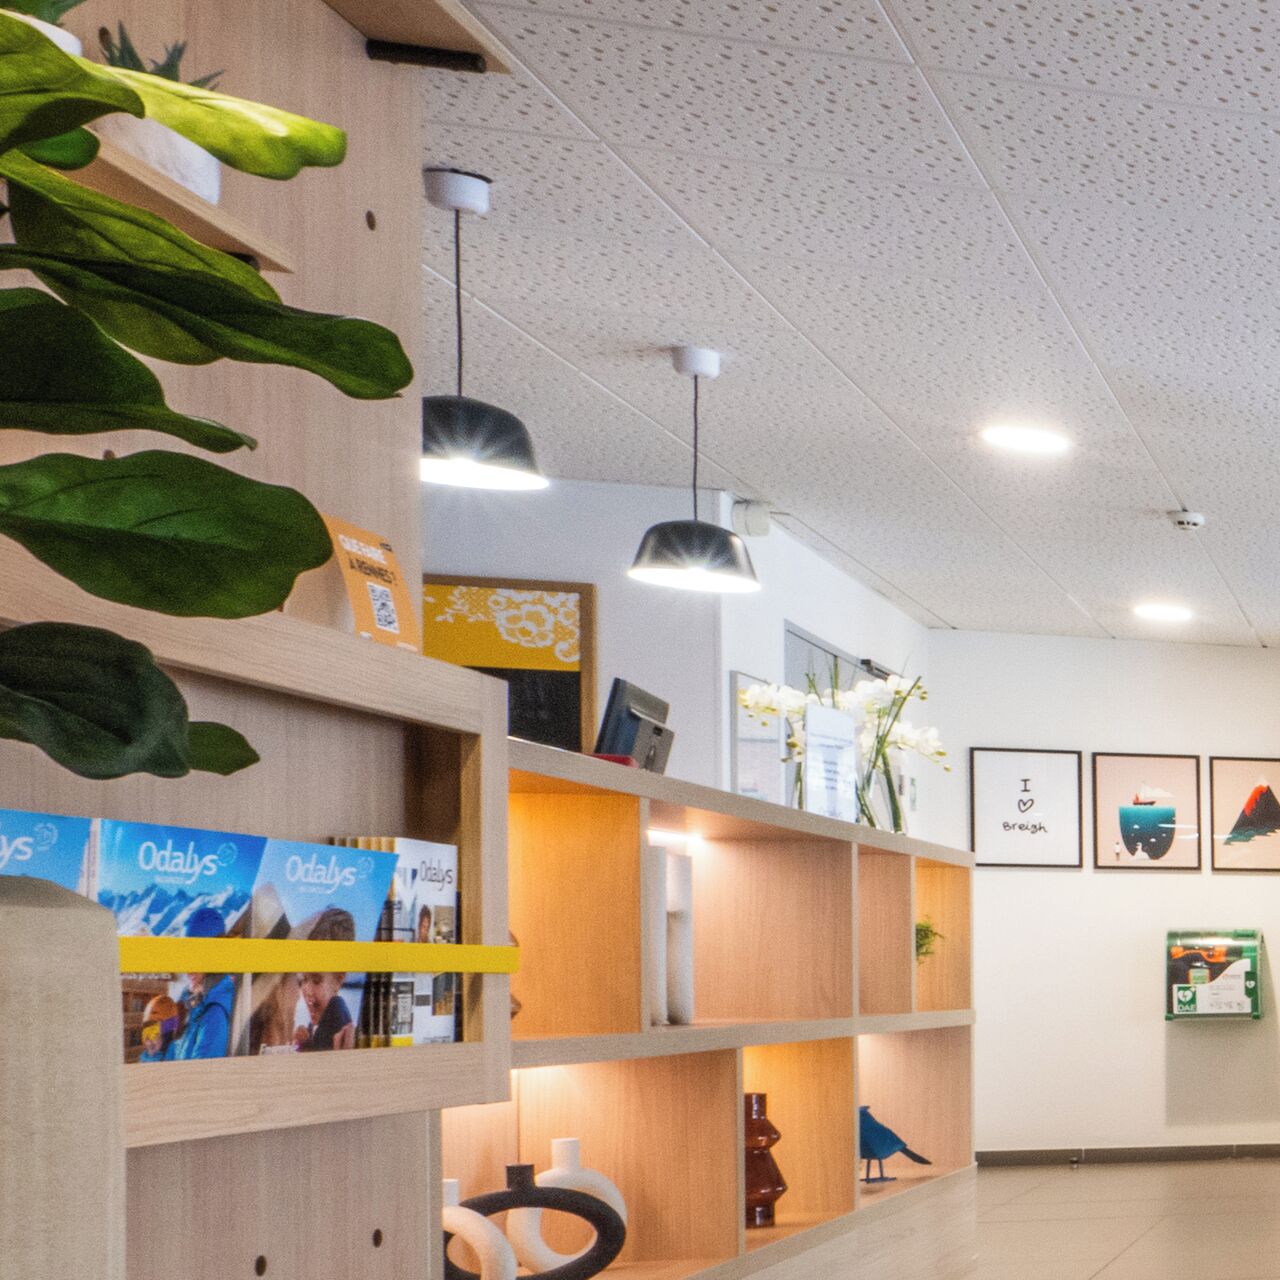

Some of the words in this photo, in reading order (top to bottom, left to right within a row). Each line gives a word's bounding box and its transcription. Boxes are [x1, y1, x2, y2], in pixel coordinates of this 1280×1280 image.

[1020, 778, 1031, 792] I
[1002, 821, 1048, 834] Breigh
[138, 839, 219, 884] Odalys
[286, 853, 356, 895] Odalys
[419, 857, 454, 891] Odalys
